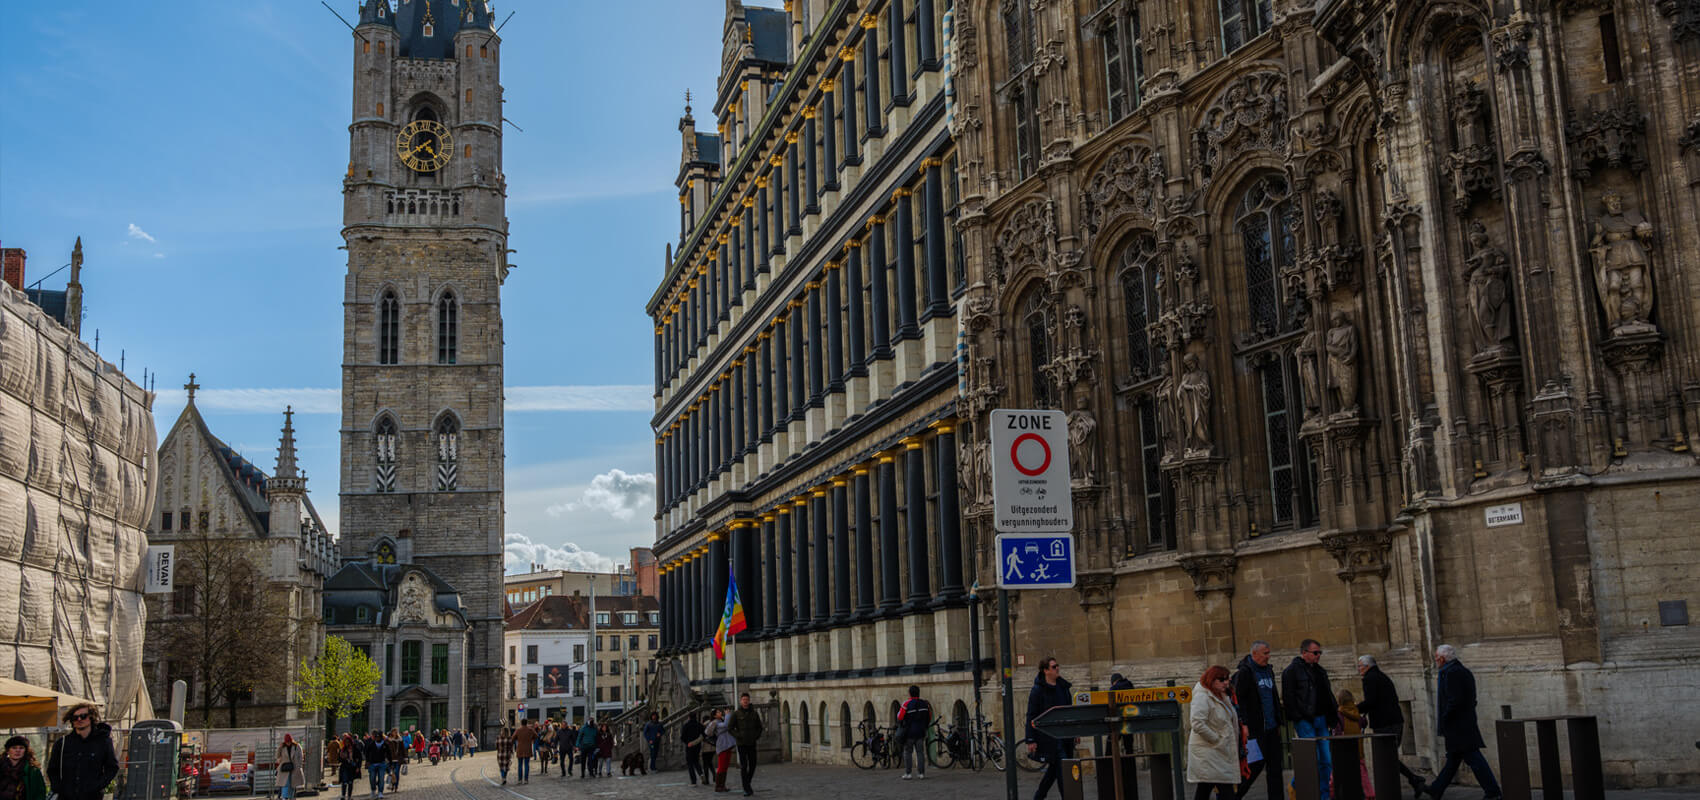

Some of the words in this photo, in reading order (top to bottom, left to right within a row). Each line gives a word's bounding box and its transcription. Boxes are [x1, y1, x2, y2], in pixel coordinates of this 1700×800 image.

[1007, 414, 1052, 430] ZONE
[1010, 504, 1058, 516] Uitgezonderd
[1001, 517, 1068, 528] vergunninghouders
[160, 552, 170, 586] DEVAN
[1117, 690, 1154, 703] Novotel
